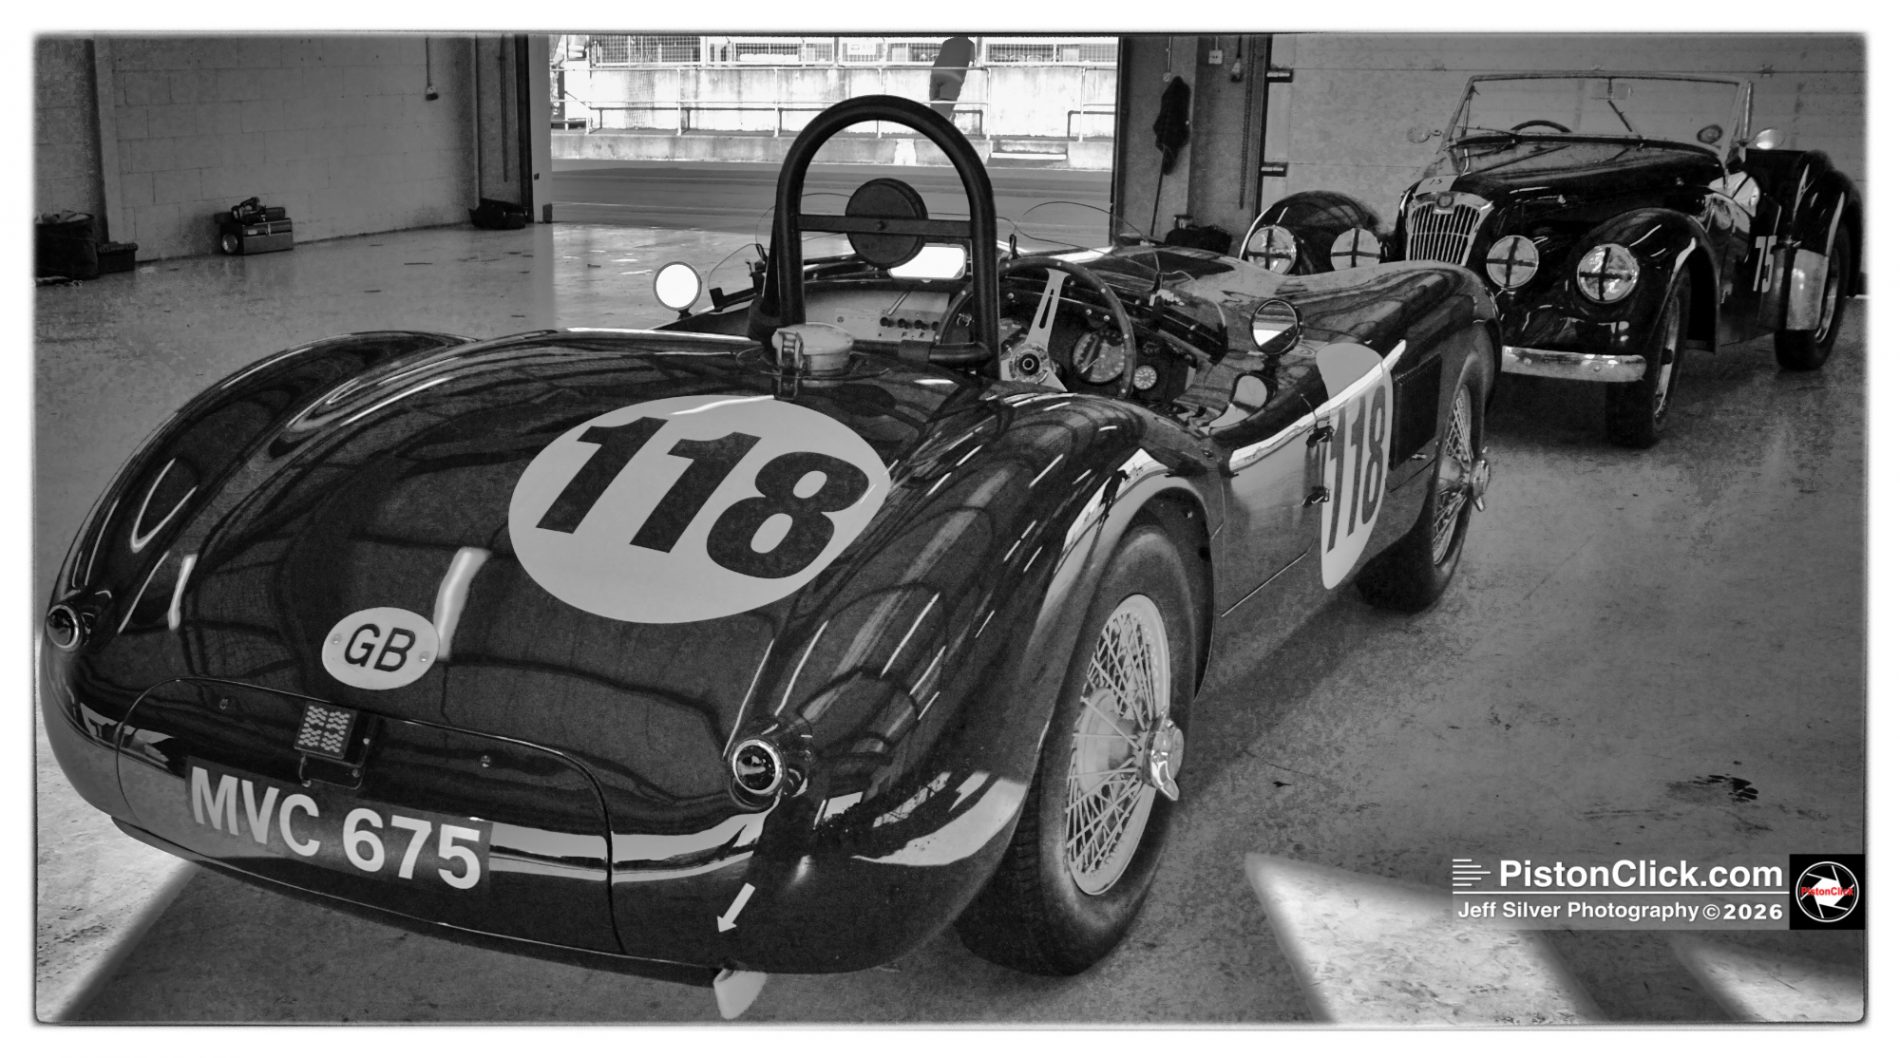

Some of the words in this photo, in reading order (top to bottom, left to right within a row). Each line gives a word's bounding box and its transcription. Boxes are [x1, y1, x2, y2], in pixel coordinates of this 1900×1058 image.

[1752, 235, 1778, 293] 75
[535, 416, 870, 579] 118
[1327, 384, 1387, 554] 118
[344, 623, 417, 673] GB
[191, 766, 321, 857] MVC
[342, 807, 481, 890] 675
